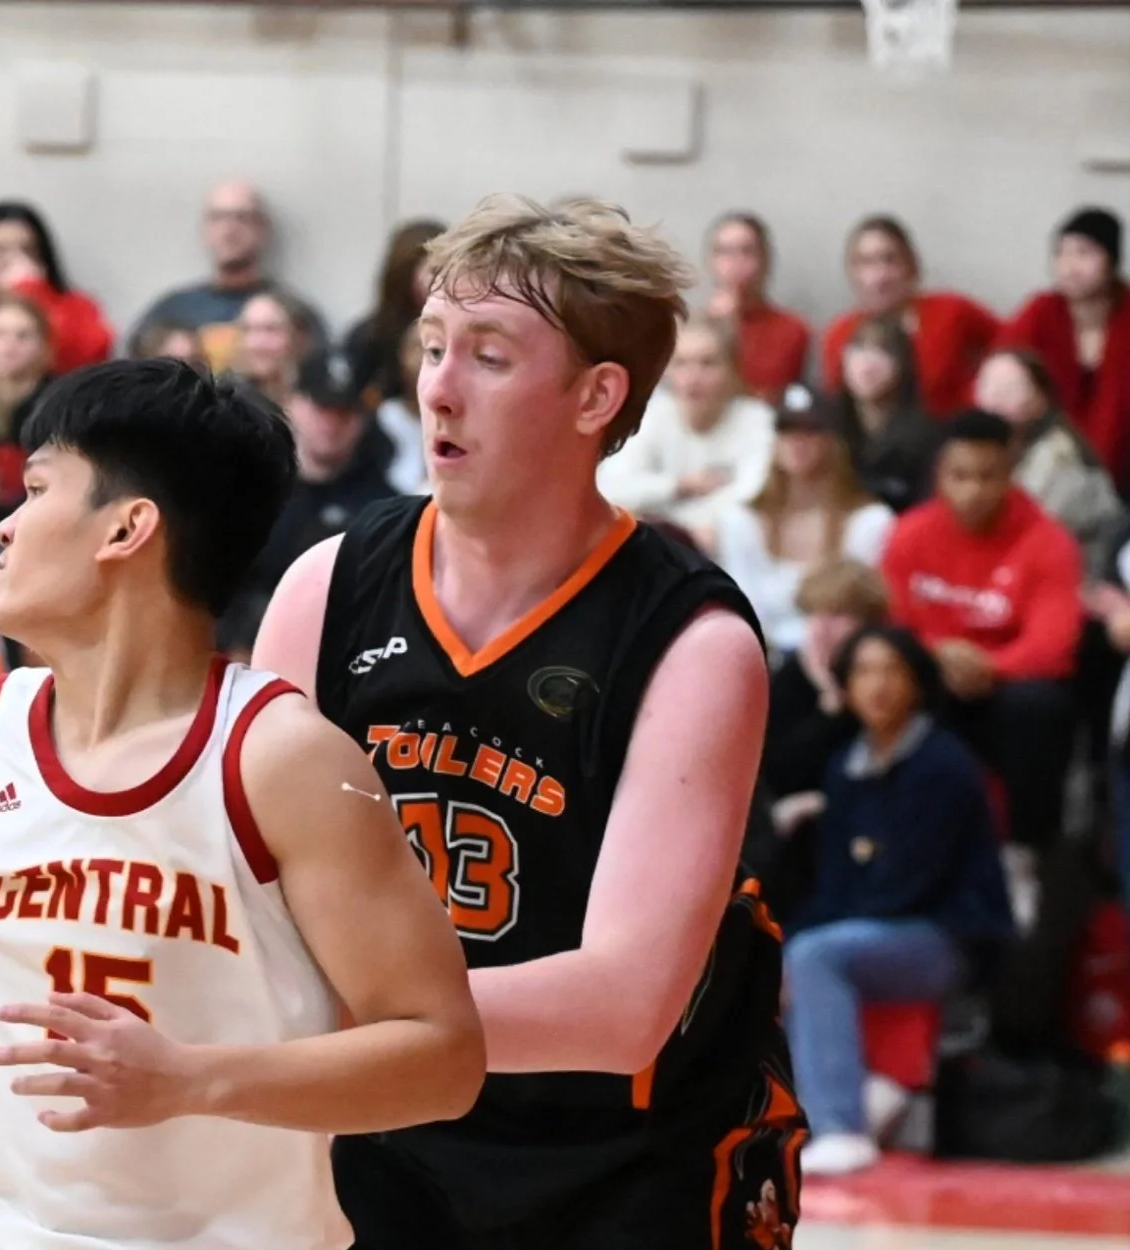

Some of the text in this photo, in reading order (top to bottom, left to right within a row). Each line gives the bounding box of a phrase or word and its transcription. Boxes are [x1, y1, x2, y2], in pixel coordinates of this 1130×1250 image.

[367, 725, 566, 817] TOILERS
[403, 718, 544, 769] EACOCK
[391, 792, 520, 942] 13
[44, 945, 153, 1041] 15
